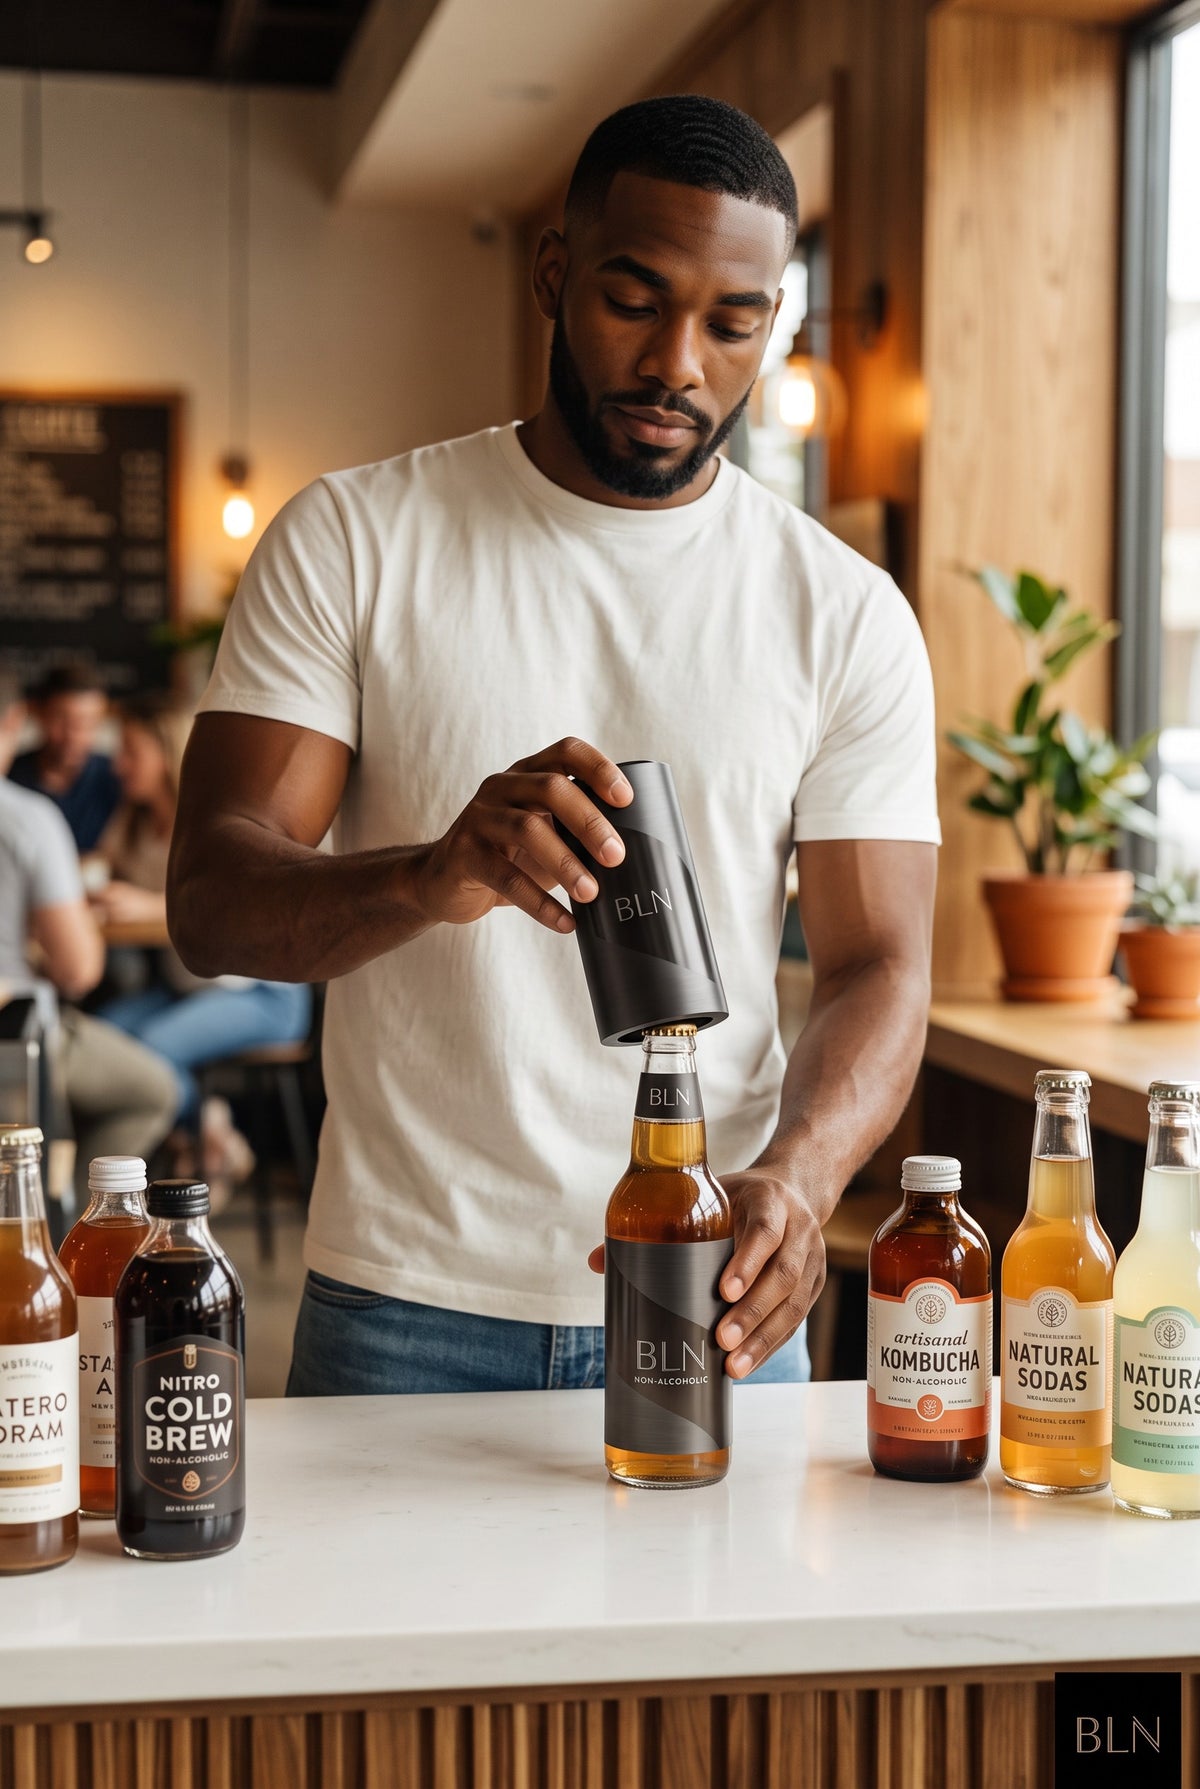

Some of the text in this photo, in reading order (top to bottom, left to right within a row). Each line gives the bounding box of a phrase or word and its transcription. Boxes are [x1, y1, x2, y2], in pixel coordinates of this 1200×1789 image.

[615, 887, 673, 922] BLN
[649, 1087, 691, 1107] BLN
[894, 1329, 969, 1346] artisanal
[636, 1339, 706, 1372] BLN
[880, 1345, 980, 1373] KOMBUCHA
[1009, 1339, 1099, 1367] NATURAL
[160, 1374, 220, 1391] NITRO
[634, 1375, 709, 1386] NON-ALCOHOLIC
[892, 1375, 967, 1386] NON-ALCOHOLIC
[1018, 1367, 1088, 1392] SODAS
[145, 1392, 233, 1423] COLD
[146, 1419, 233, 1452] BREW
[149, 1451, 230, 1465] NON-ALCOHOLIC
